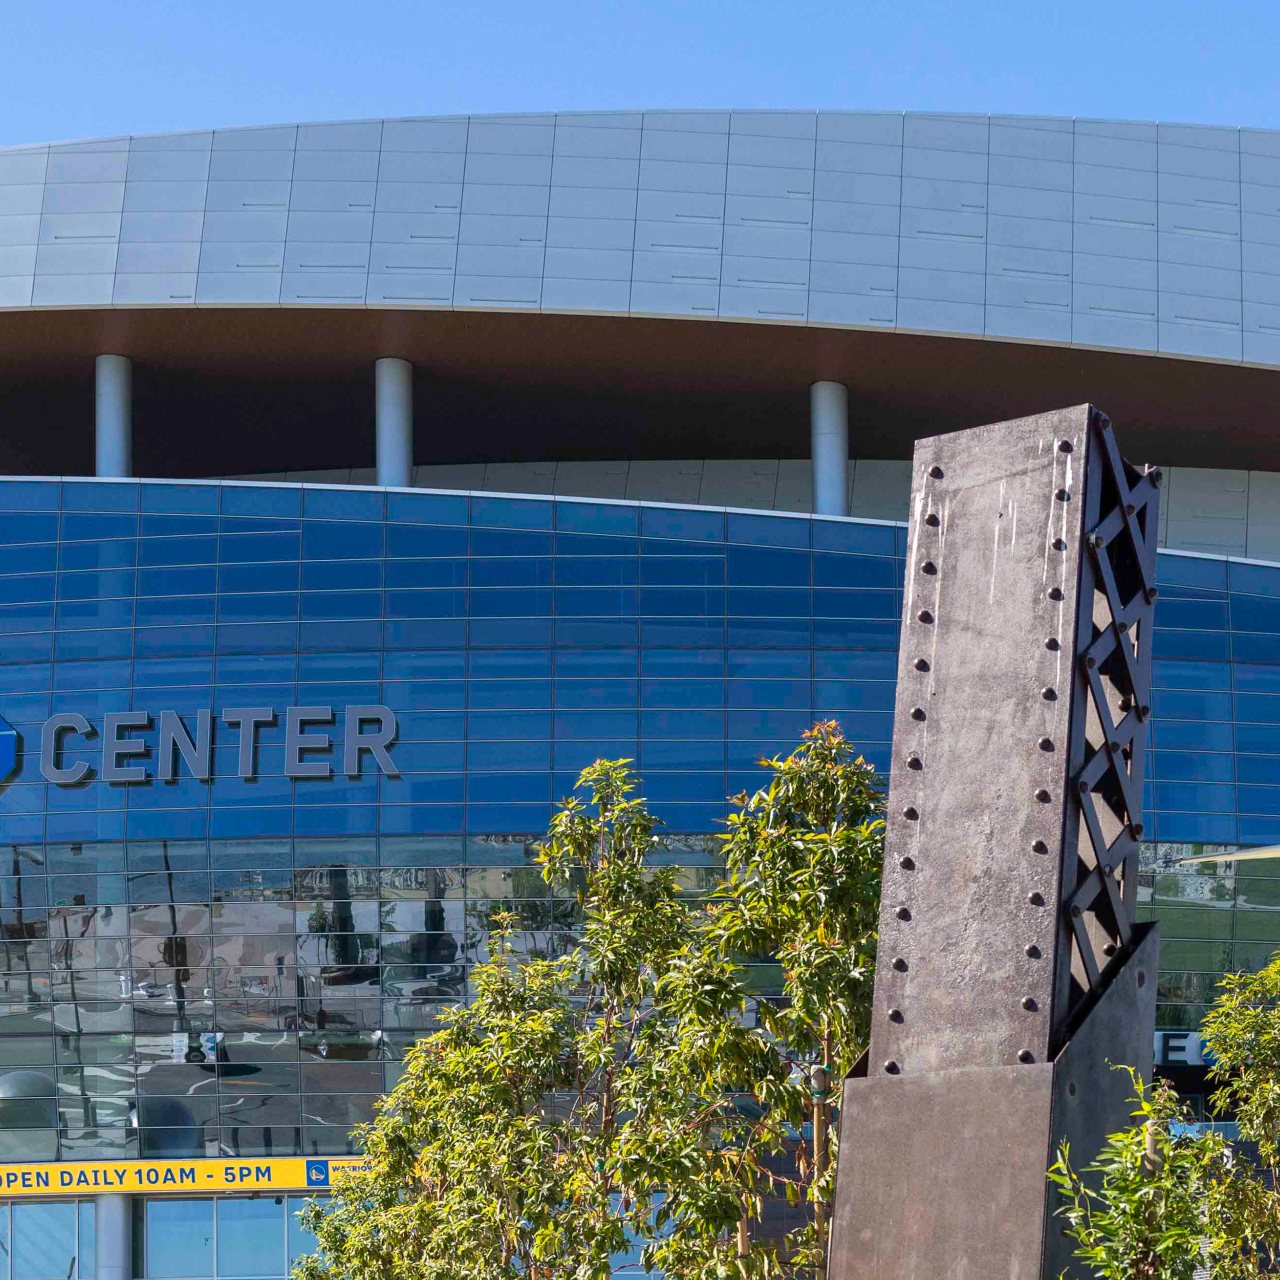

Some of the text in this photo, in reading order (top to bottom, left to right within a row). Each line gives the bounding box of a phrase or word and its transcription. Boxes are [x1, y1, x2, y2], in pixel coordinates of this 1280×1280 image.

[39, 704, 402, 784] CENTER
[60, 1169, 126, 1187] DAILY
[134, 1167, 197, 1186] 10AM
[224, 1166, 272, 1183] 5PM
